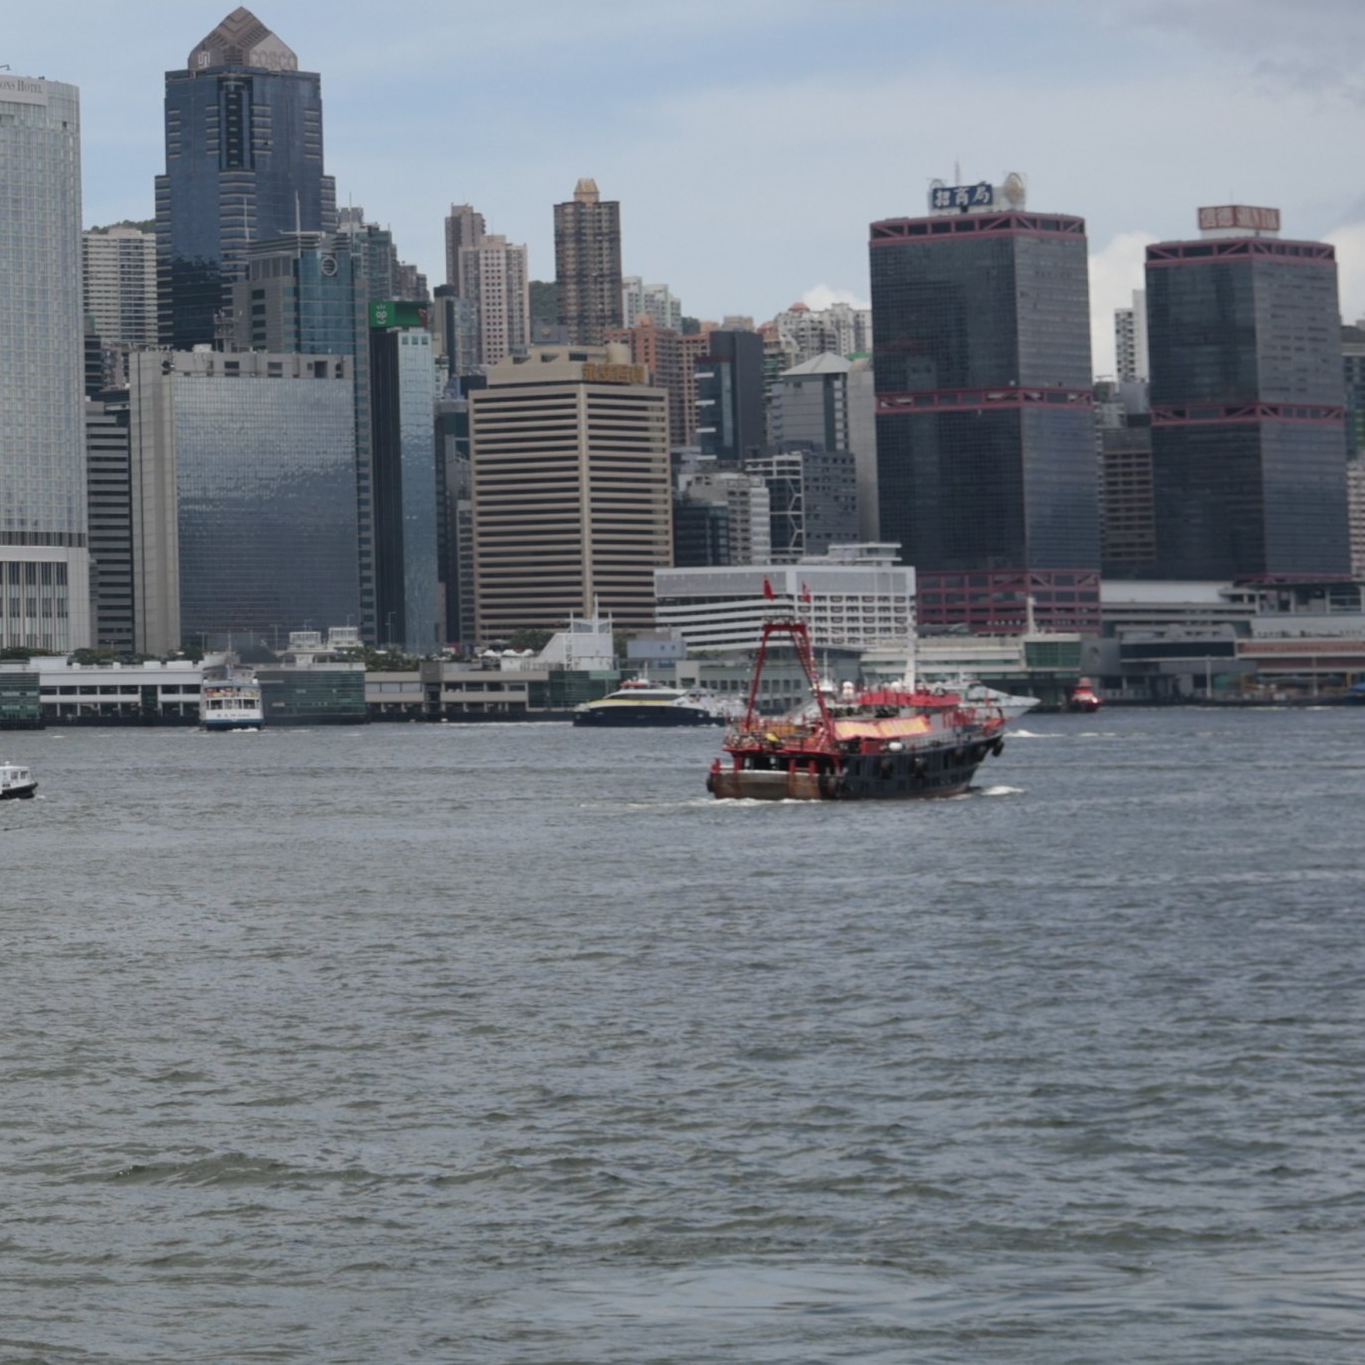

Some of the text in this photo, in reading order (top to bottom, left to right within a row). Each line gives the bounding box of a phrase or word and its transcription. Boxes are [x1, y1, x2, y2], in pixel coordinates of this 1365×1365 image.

[17, 80, 43, 94] HOTEL
[934, 186, 990, 207] 招商局
